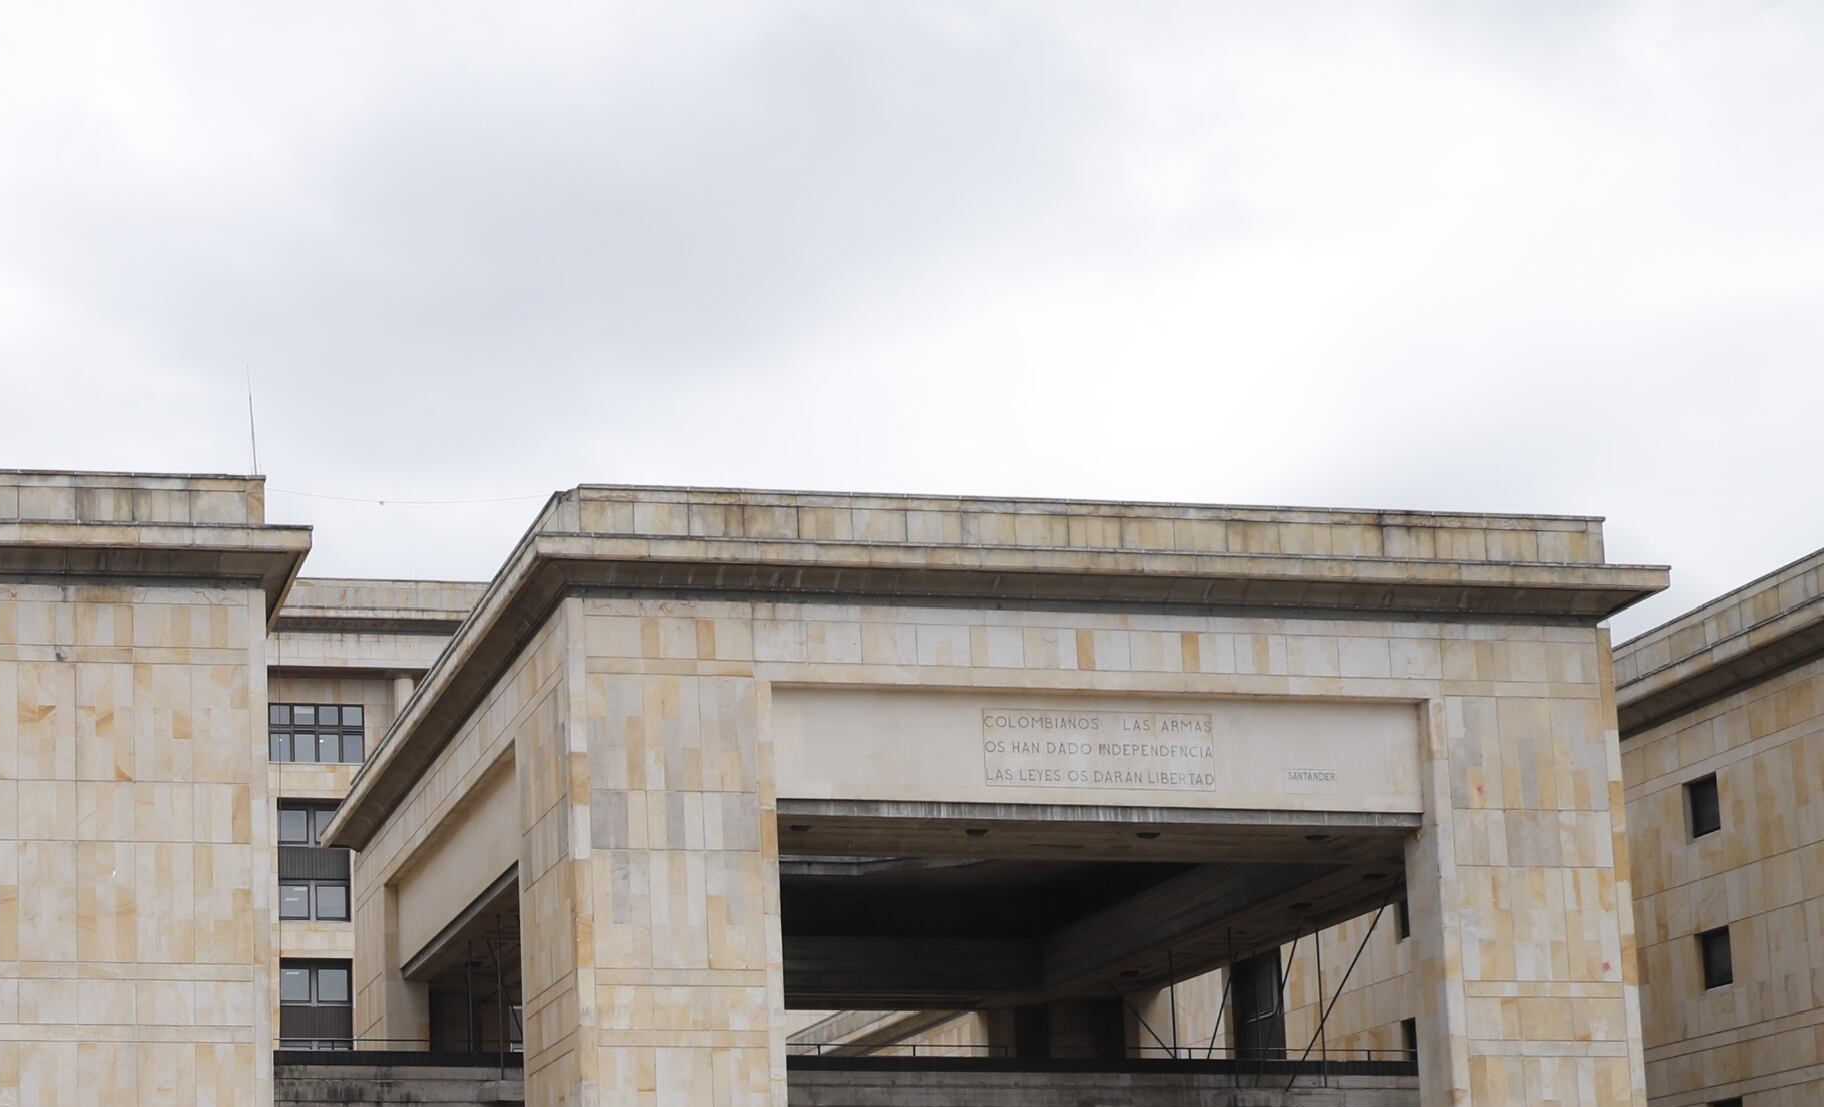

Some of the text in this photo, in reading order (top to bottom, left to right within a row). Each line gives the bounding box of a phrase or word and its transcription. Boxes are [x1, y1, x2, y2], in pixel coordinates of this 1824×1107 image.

[984, 715, 1212, 732] COLOMBIANOS LAS ARMAS
[984, 740, 1213, 758] OS HAN DADO INDEPENDENCIA
[986, 768, 1013, 781] LAS
[1019, 769, 1061, 781] LEYES
[1067, 770, 1088, 782] OS
[1147, 771, 1214, 785] LIBERTAD
[1287, 771, 1336, 781] SANTANDER
